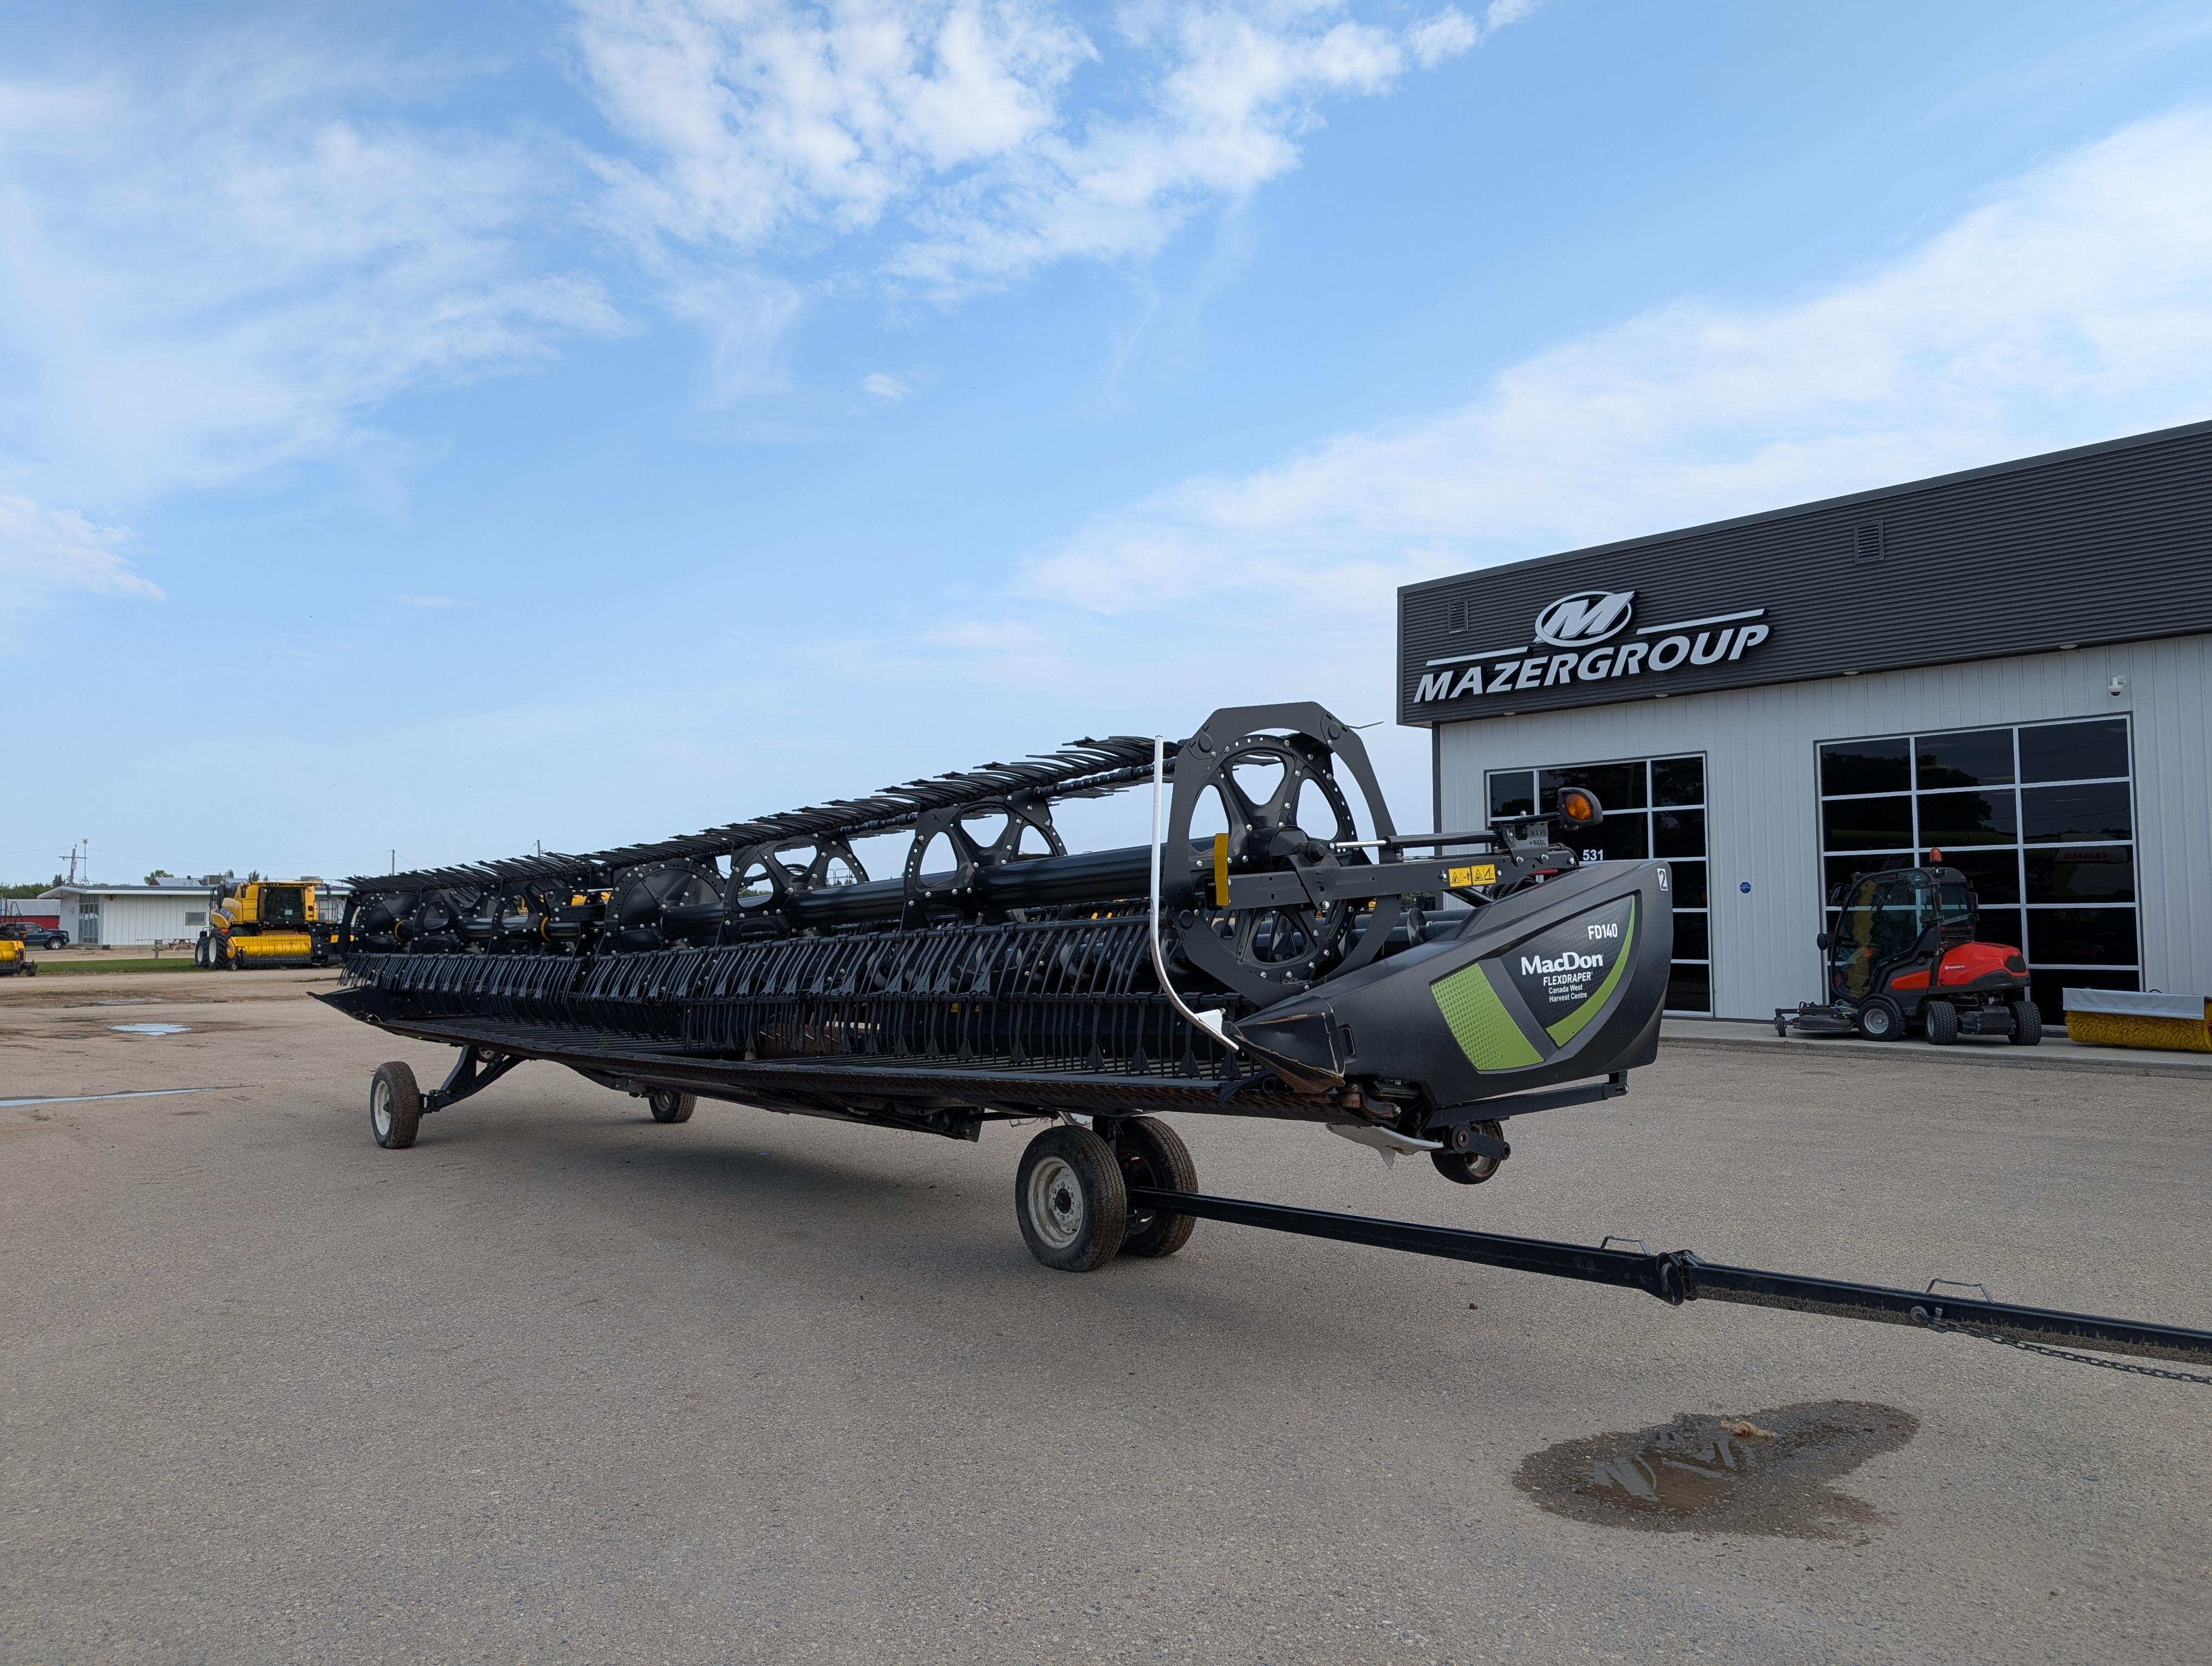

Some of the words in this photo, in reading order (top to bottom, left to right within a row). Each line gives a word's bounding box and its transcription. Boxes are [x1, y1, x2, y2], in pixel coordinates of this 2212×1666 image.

[1413, 624, 1769, 703] MAZERGROUP
[1583, 849, 1603, 861] 531
[1659, 870, 1667, 890] 2
[1587, 923, 1618, 940] FD140
[1521, 952, 1603, 975] MacDon
[1543, 971, 1591, 986] FLEXDRAPER
[1548, 985, 1569, 994] Canada
[1549, 994, 1570, 1003] Harvest
[1571, 992, 1587, 1000] Centre
